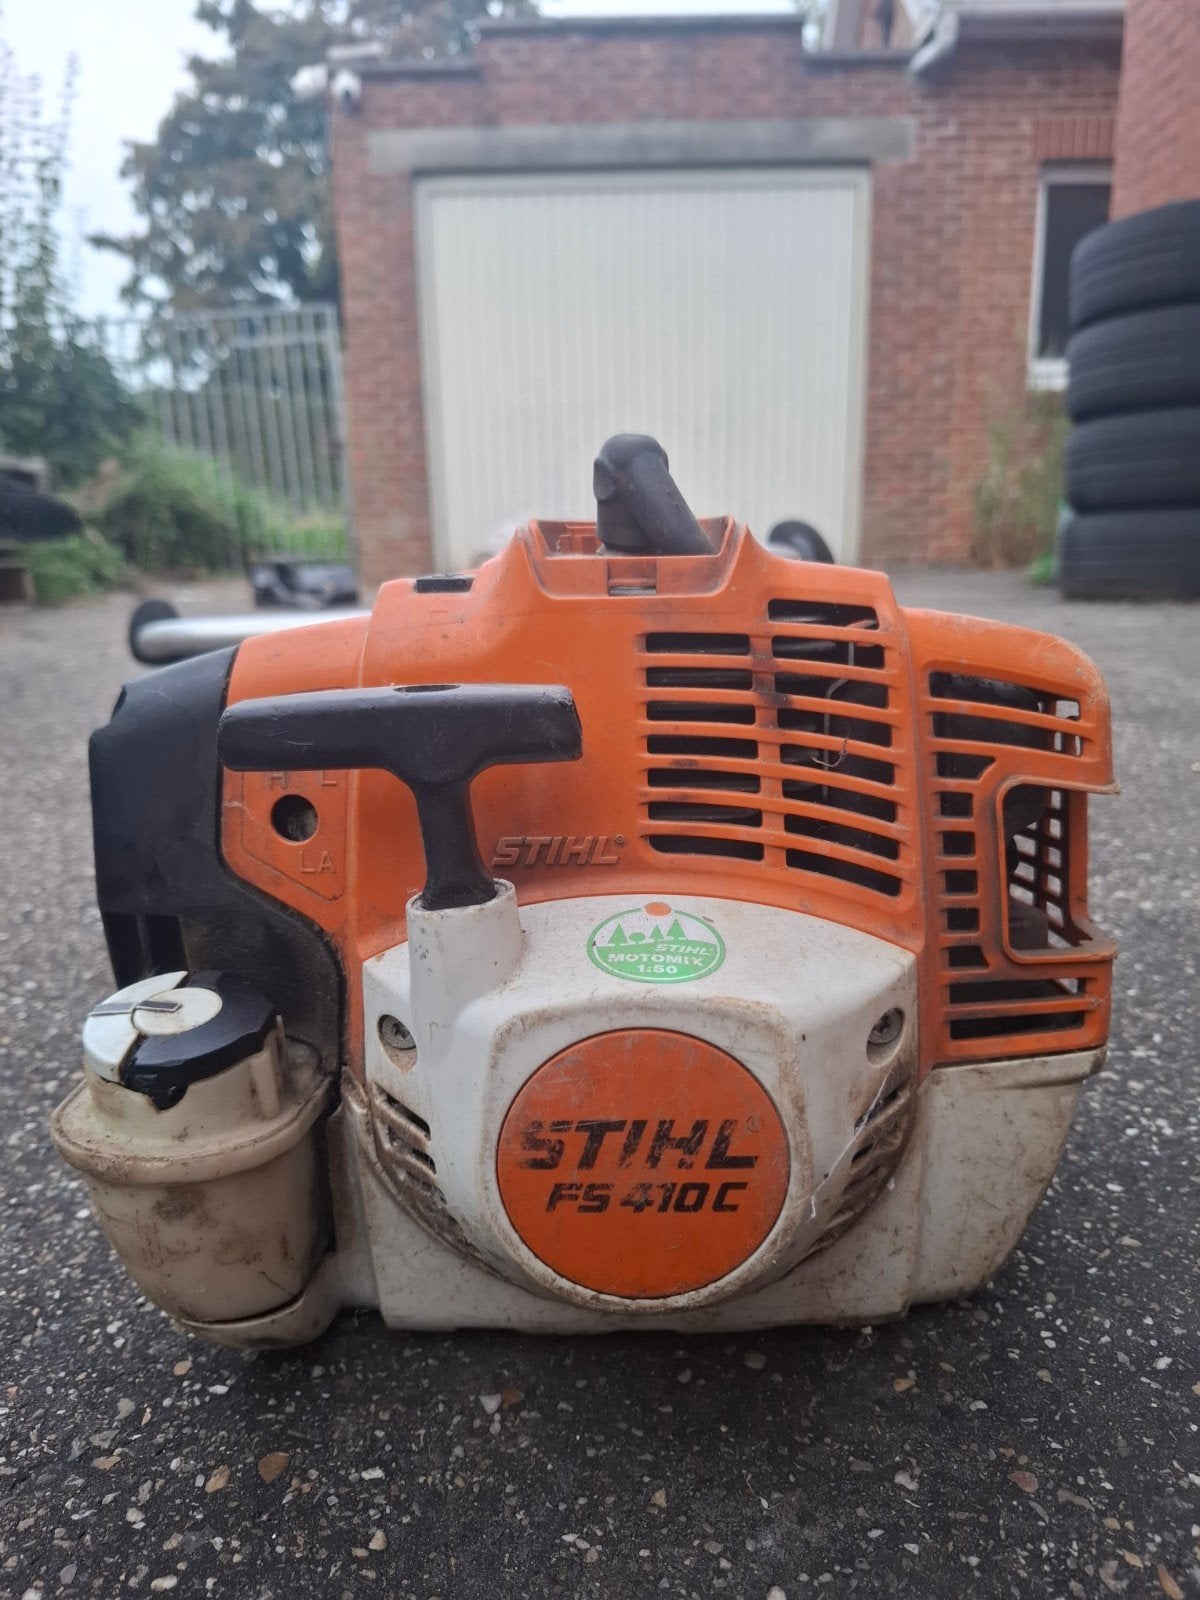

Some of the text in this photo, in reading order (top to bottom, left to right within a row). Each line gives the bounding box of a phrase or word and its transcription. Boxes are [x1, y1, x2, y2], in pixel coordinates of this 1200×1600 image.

[299, 850, 336, 874] LA
[608, 953, 703, 967] MOTOMIX
[637, 964, 678, 974] 1:50
[546, 1182, 748, 1213] FS 410 C
